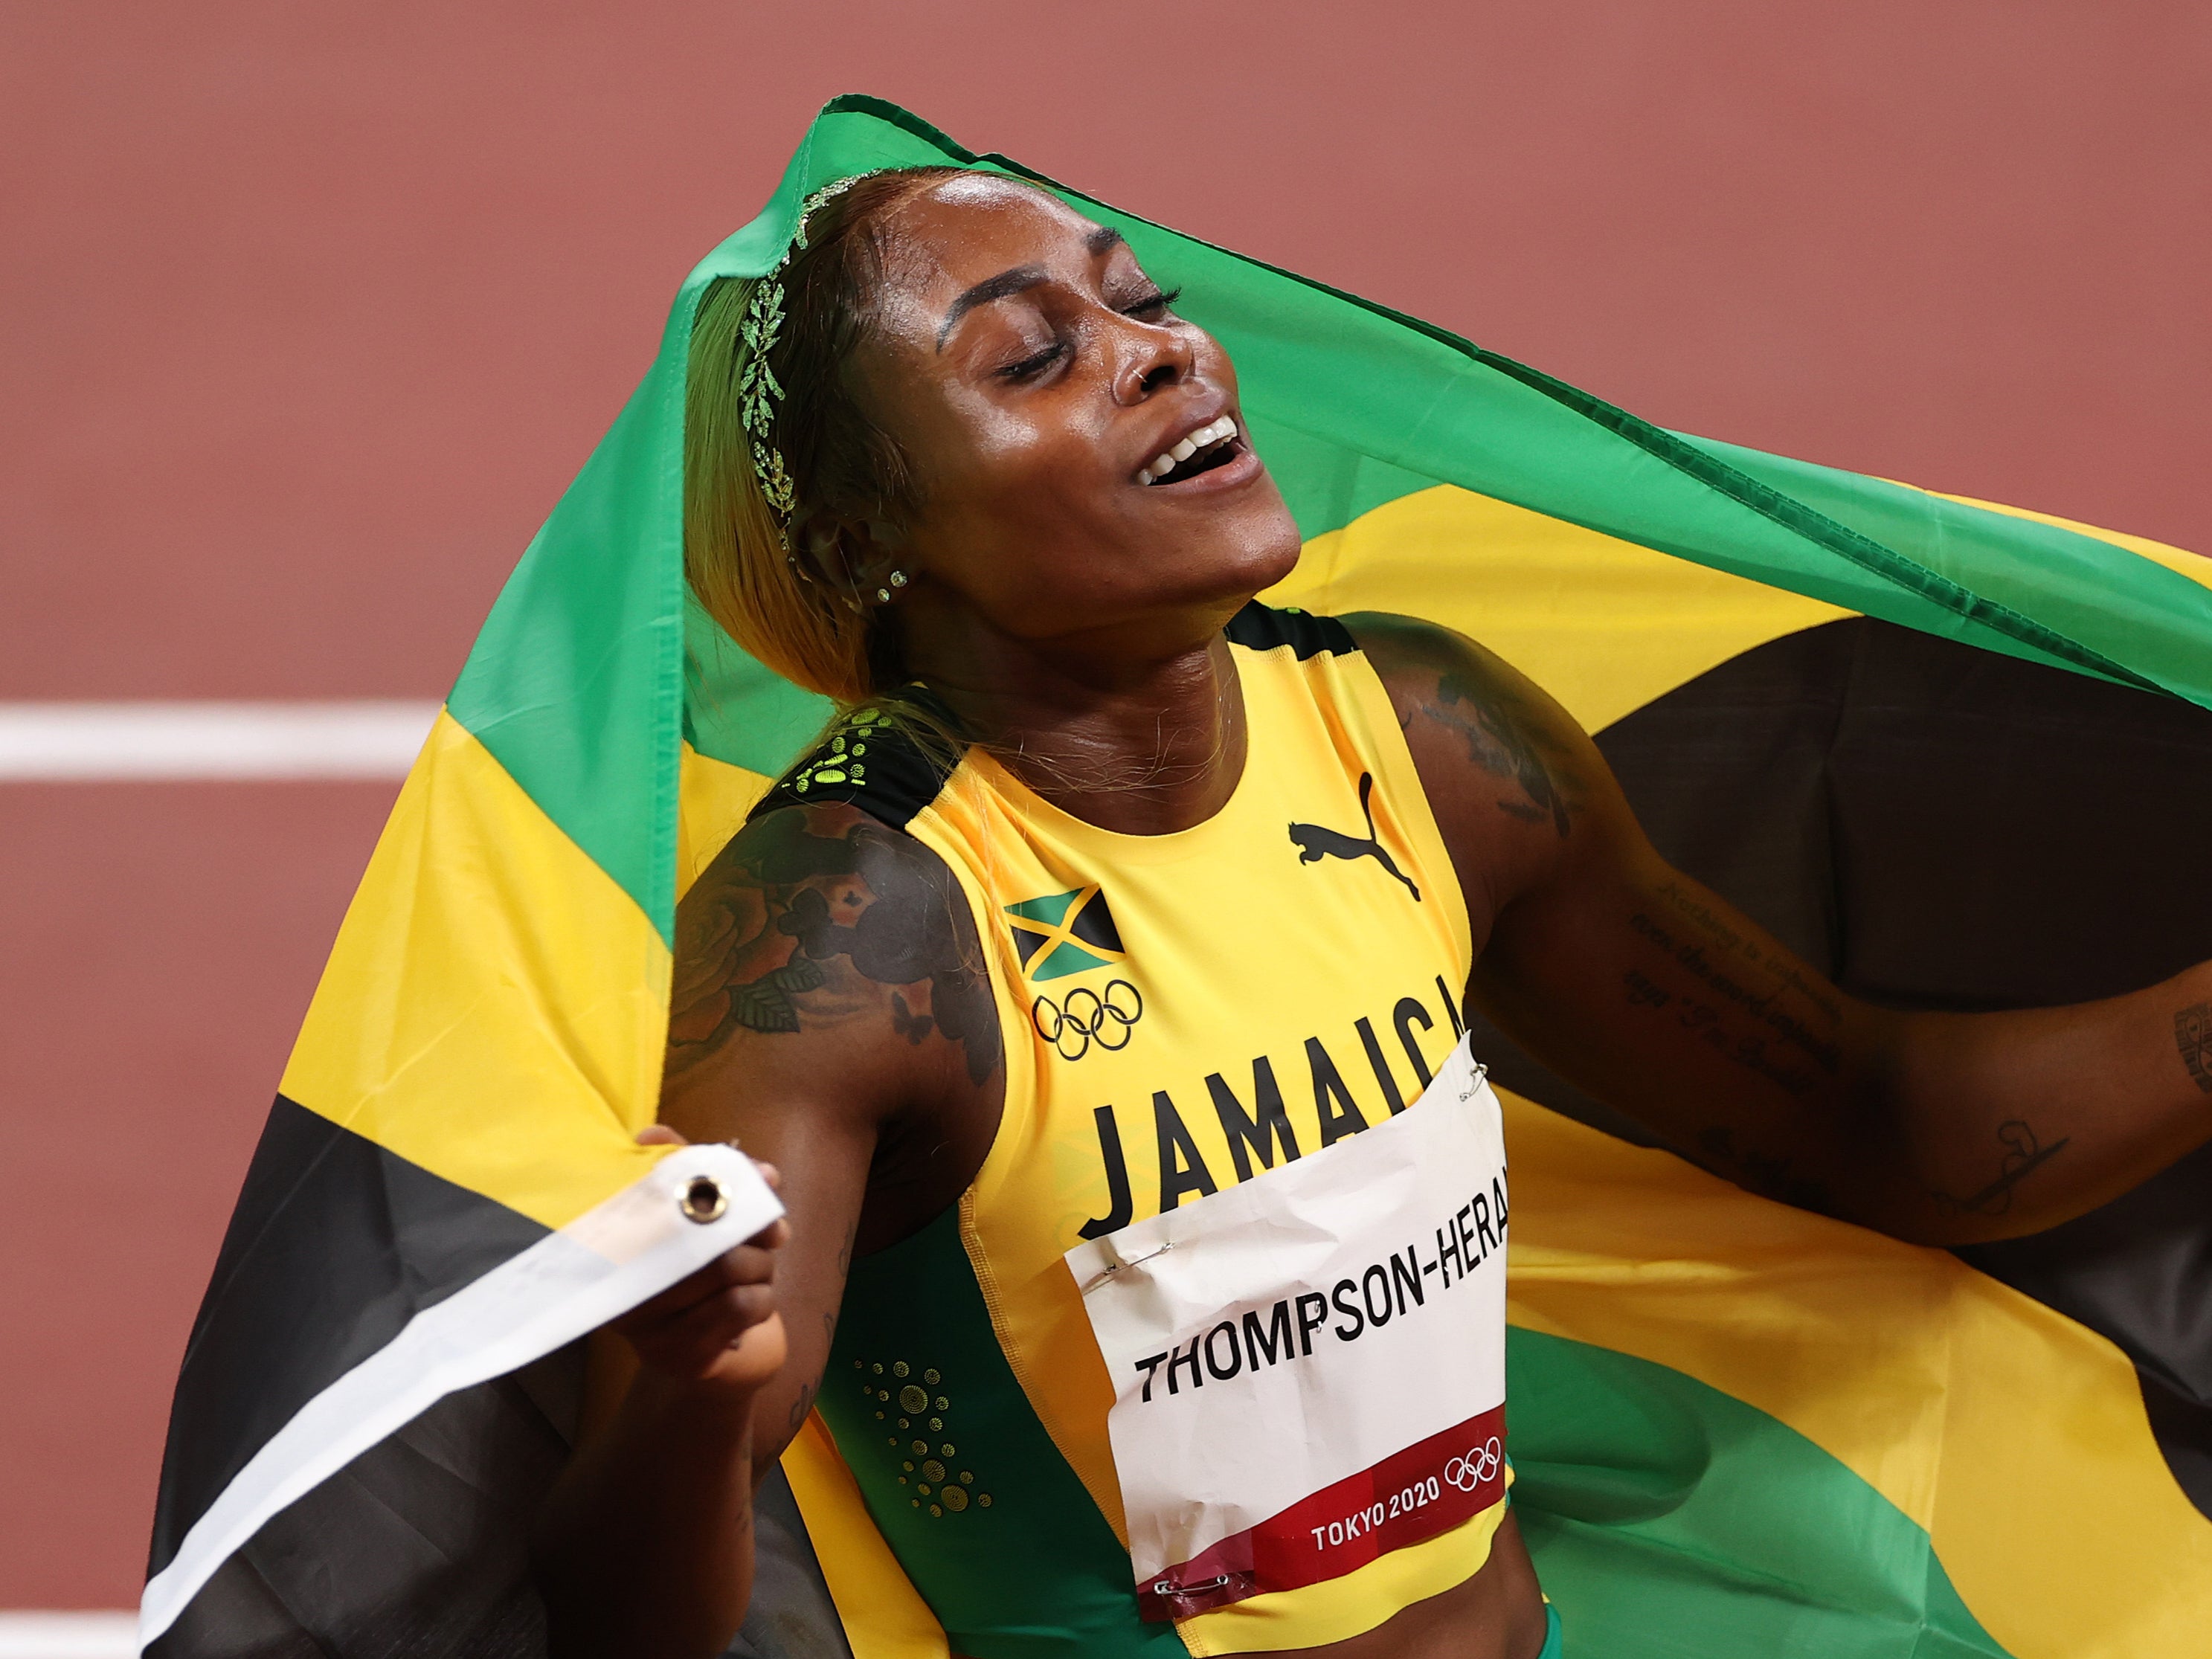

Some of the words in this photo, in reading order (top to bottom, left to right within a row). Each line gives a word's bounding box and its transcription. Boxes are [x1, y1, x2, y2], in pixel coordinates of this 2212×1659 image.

[1134, 1165, 1508, 1403] THOMPSON-HERA
[1311, 1502, 1385, 1551] TOKYO
[1389, 1476, 1441, 1519] 2020
